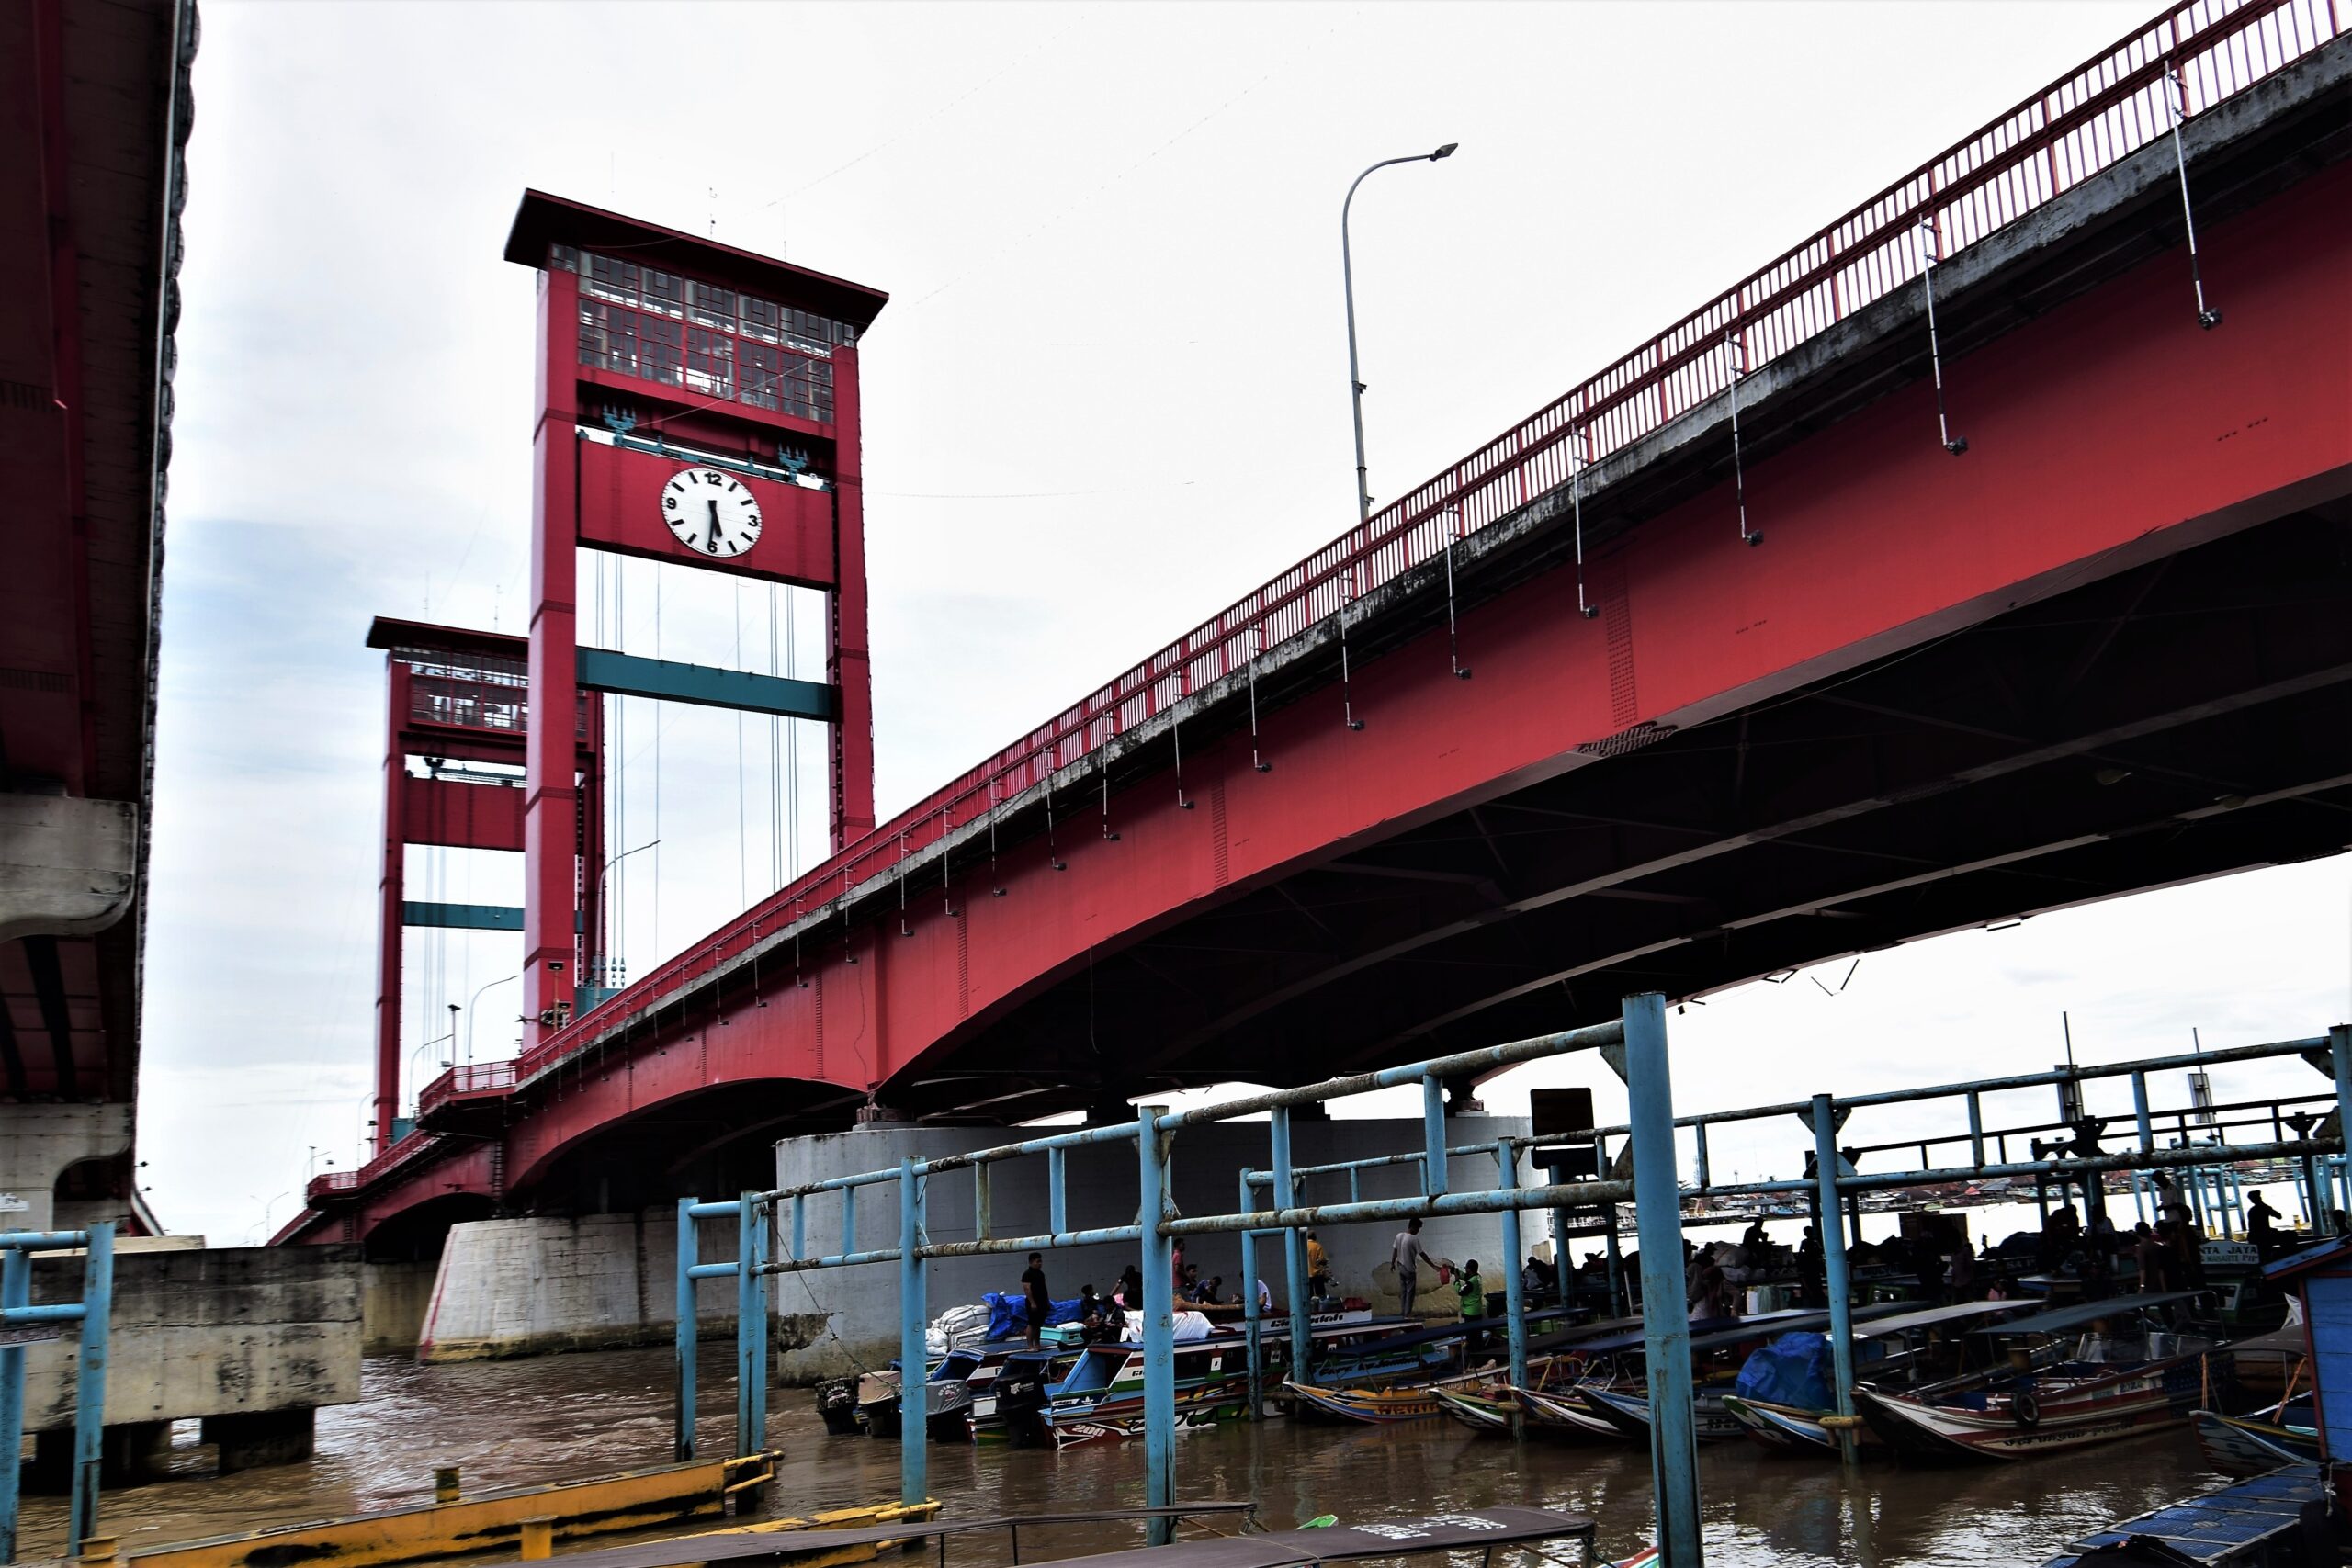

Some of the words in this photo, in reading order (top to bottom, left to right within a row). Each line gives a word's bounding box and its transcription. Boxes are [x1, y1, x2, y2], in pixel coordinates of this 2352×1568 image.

[704, 471, 722, 487] 12
[666, 497, 677, 510] 9
[748, 514, 758, 527] 3
[707, 541, 718, 553] 6
[2227, 1246, 2257, 1254] JAYA
[1071, 1424, 1106, 1438] 200
